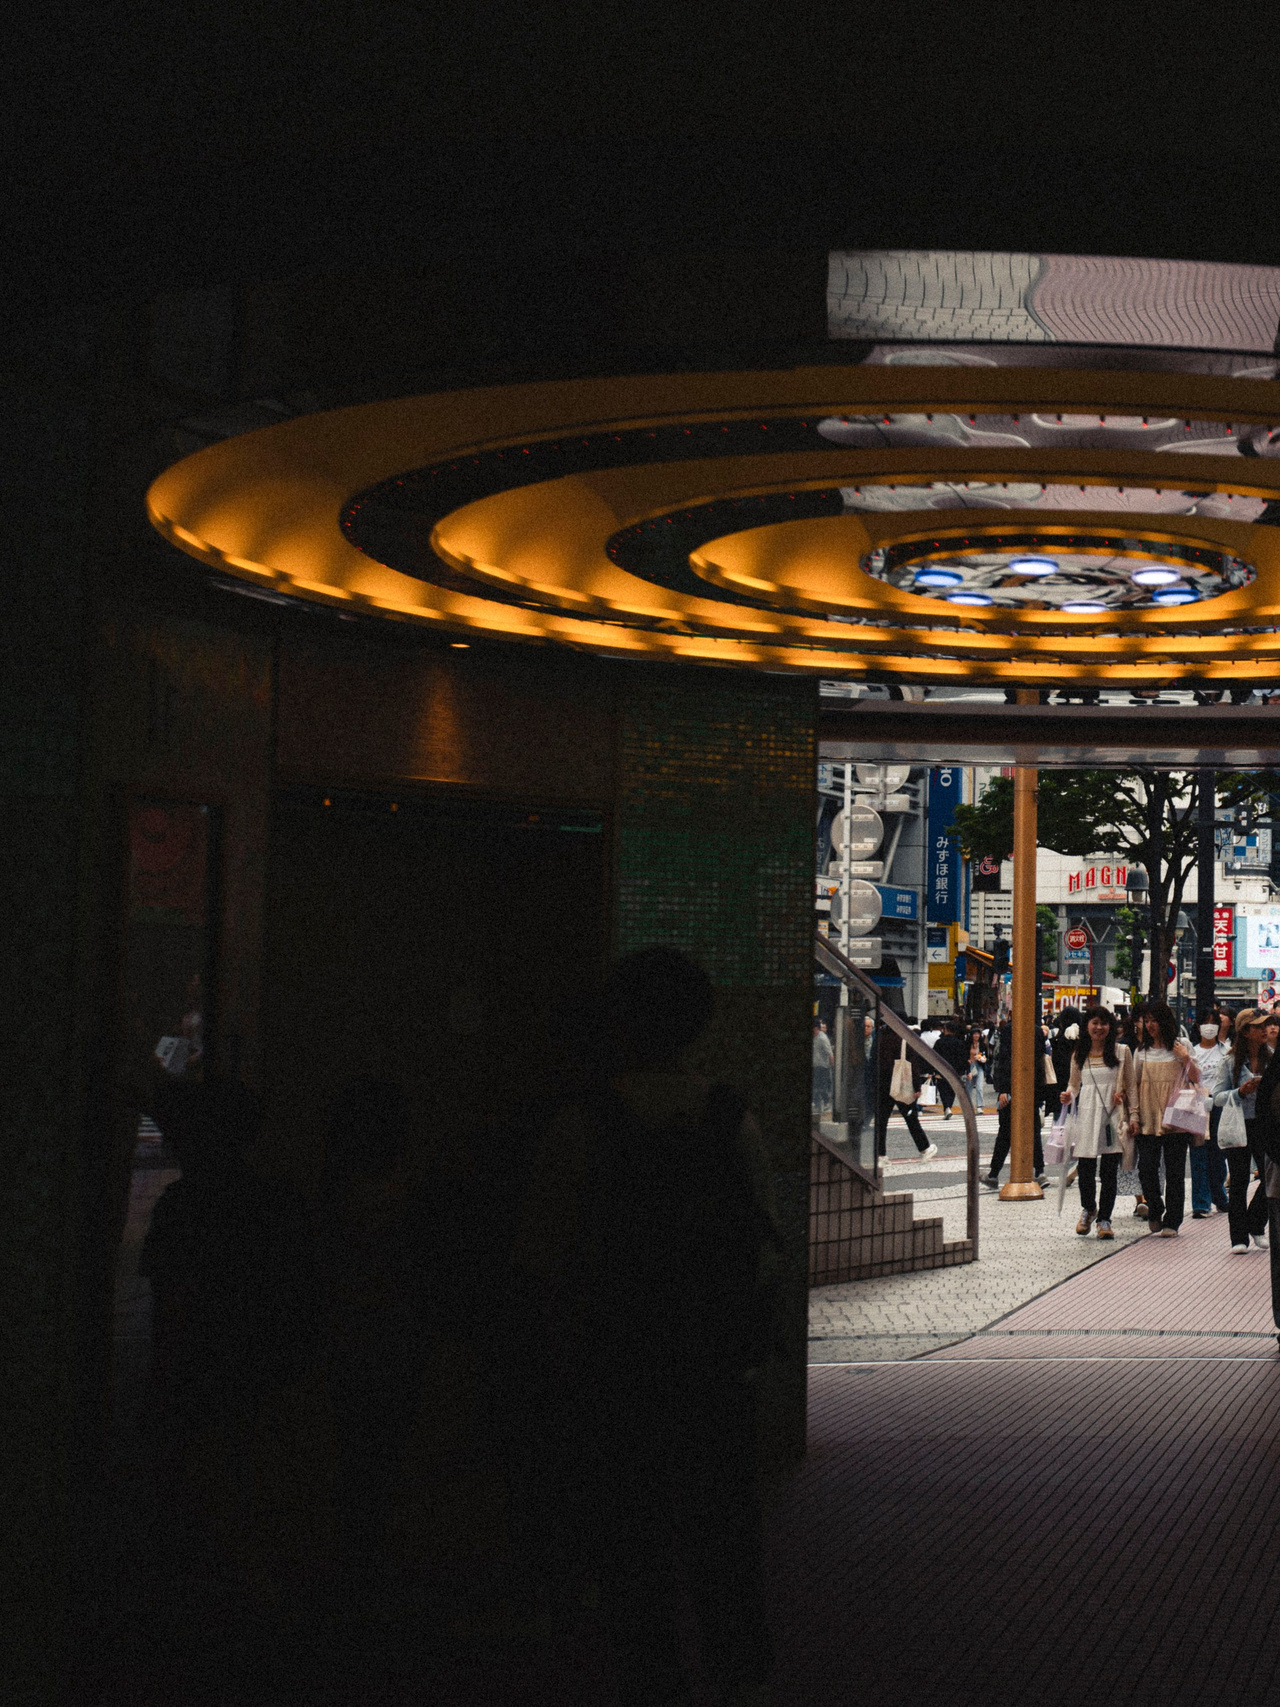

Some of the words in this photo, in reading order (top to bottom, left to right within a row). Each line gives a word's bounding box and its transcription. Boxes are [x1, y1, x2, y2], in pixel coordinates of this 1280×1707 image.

[935, 836, 949, 904] みずほ銀行
[1053, 995, 1087, 1013] LOVE
